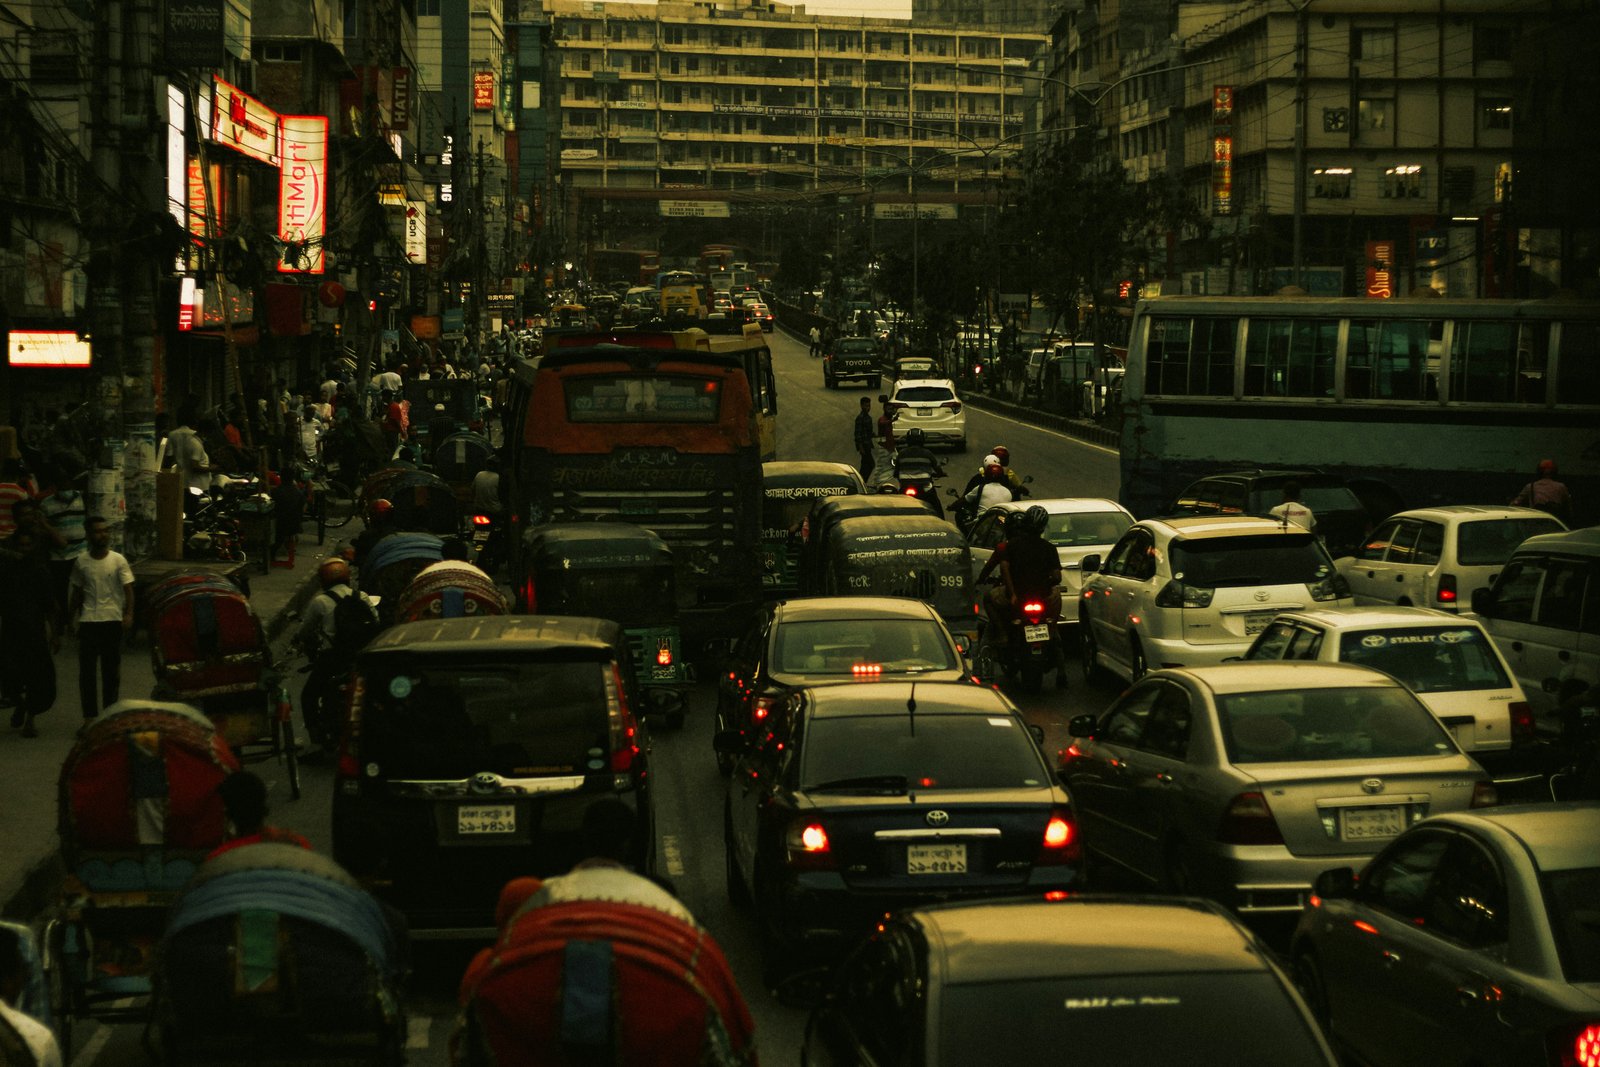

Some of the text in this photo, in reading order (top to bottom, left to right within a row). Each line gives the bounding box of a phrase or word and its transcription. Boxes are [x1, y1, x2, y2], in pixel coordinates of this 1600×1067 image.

[394, 74, 408, 123] HATIL
[409, 219, 418, 237] UCB
[940, 575, 963, 587] 999
[1390, 635, 1436, 645] STARLET
